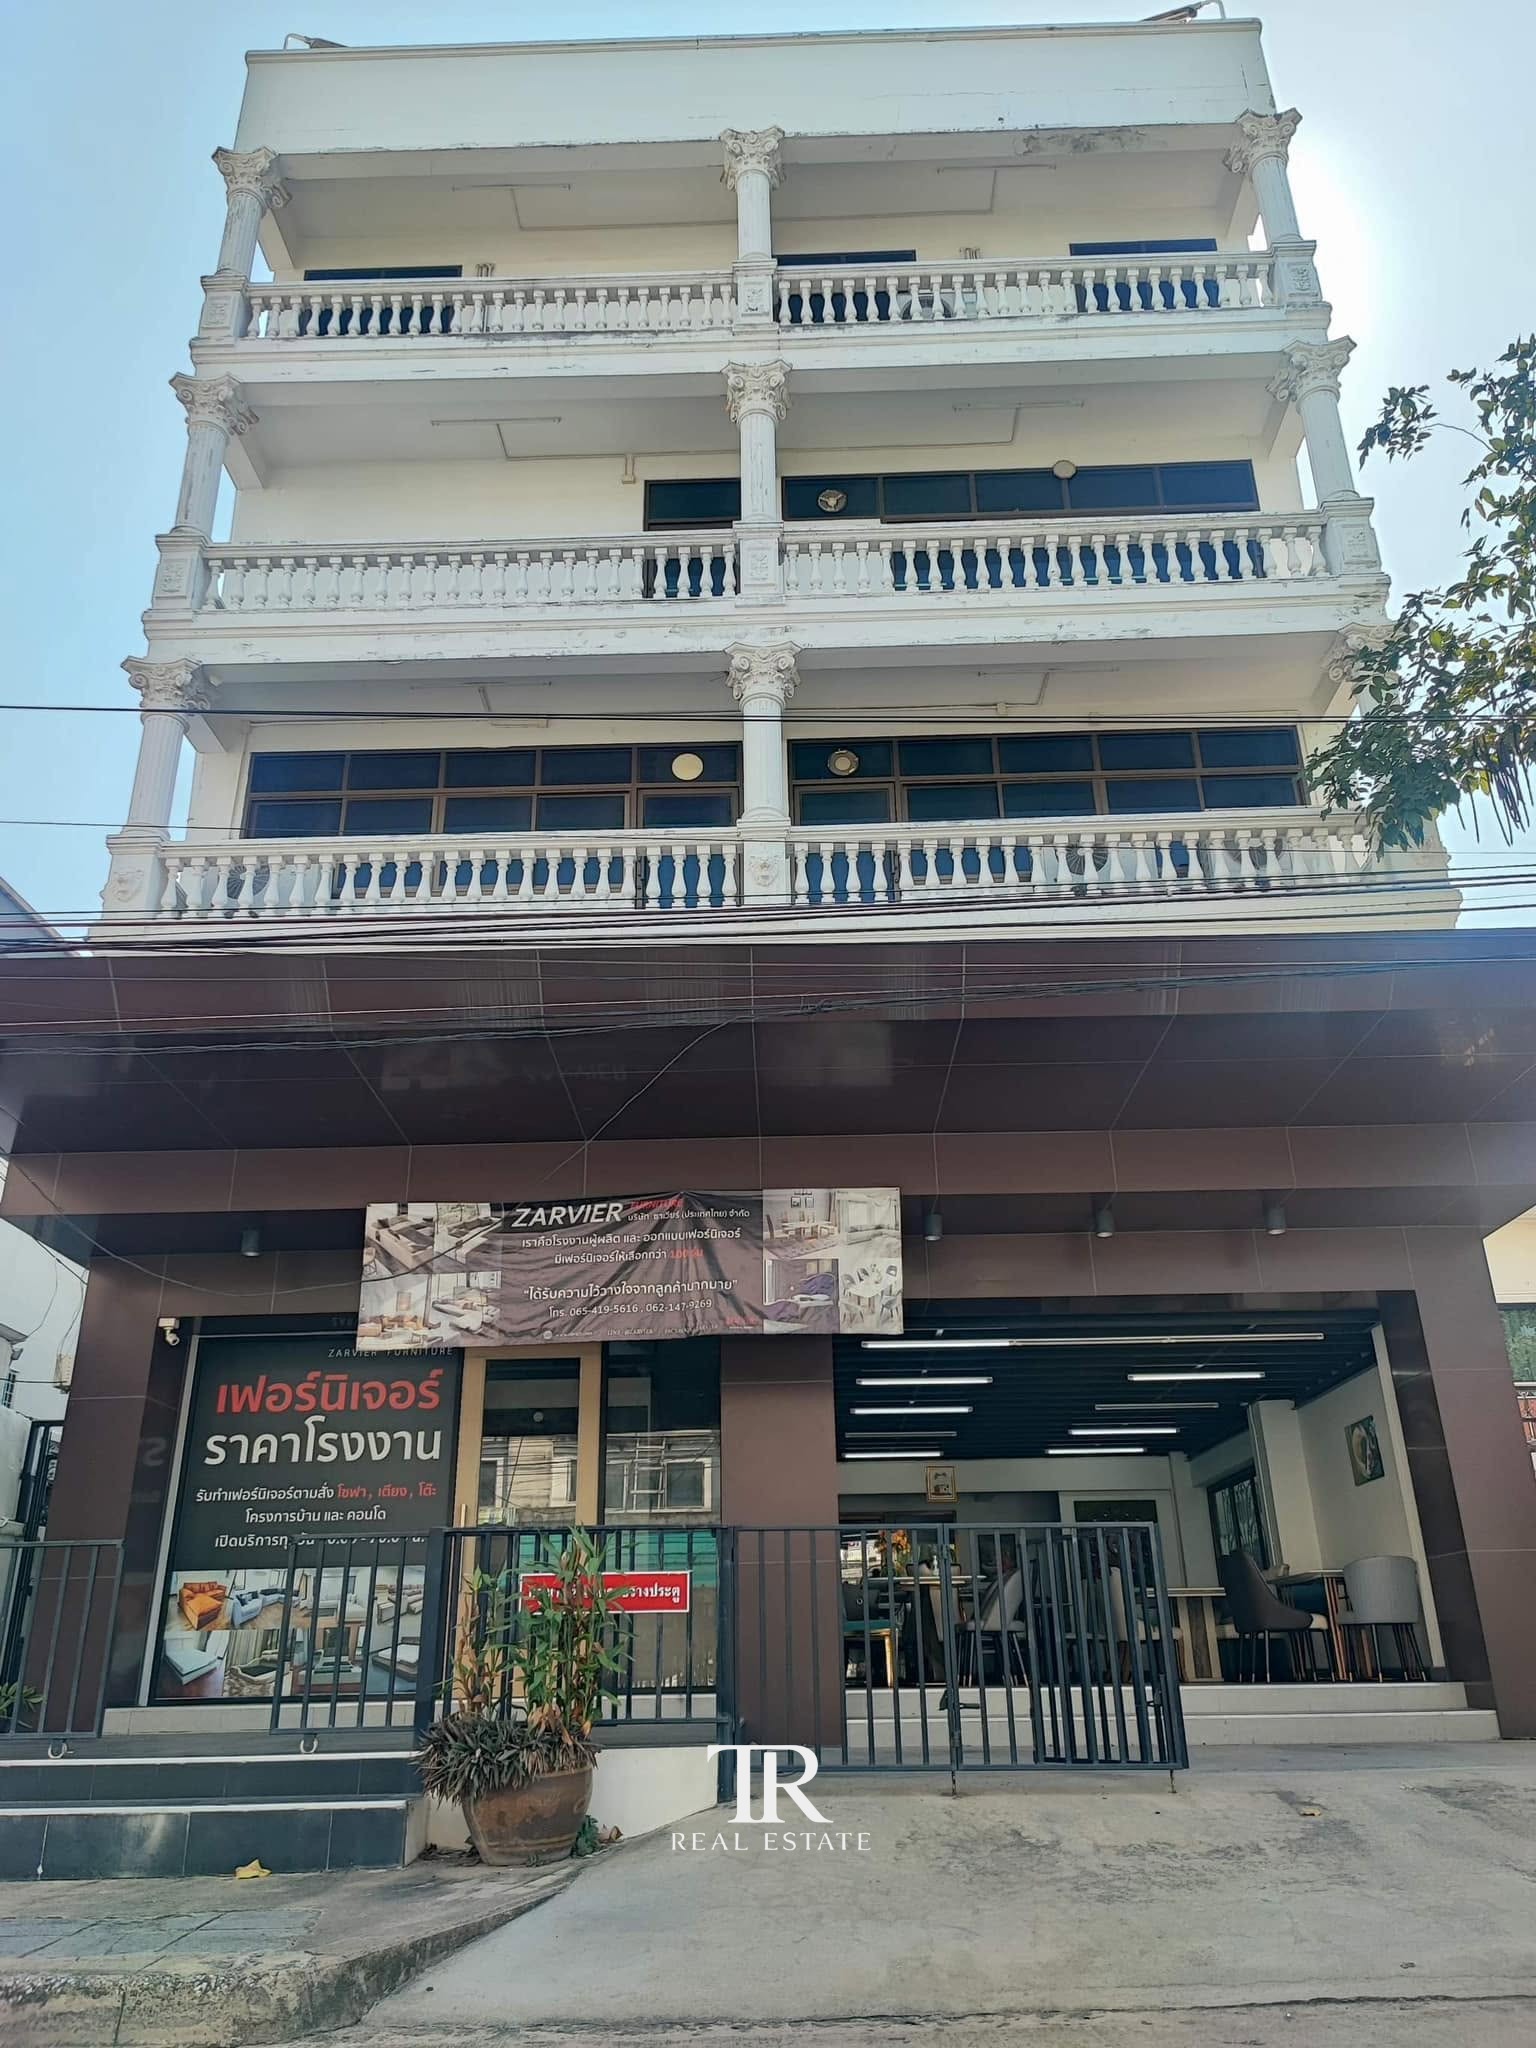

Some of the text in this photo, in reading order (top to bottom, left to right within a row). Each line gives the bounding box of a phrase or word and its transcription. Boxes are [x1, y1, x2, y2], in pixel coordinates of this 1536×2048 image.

[511, 1202, 624, 1229] ZARVIER
[521, 1227, 742, 1248] เราคือโรงงานผู้ผลิต และ ออกแบบเฟอร์นิเจอร์
[569, 1304, 638, 1316] 065-419-5616
[646, 1299, 712, 1313] 062-147-9269
[216, 1368, 444, 1414] เฟอร์นิเจอร์
[204, 1415, 442, 1466] ราคาโรงงาน
[196, 1482, 334, 1502] รับทำเฟอร์นิเจอร์ตามสั่ง
[246, 1504, 386, 1524] โครงการบ้าน และ คอนโด
